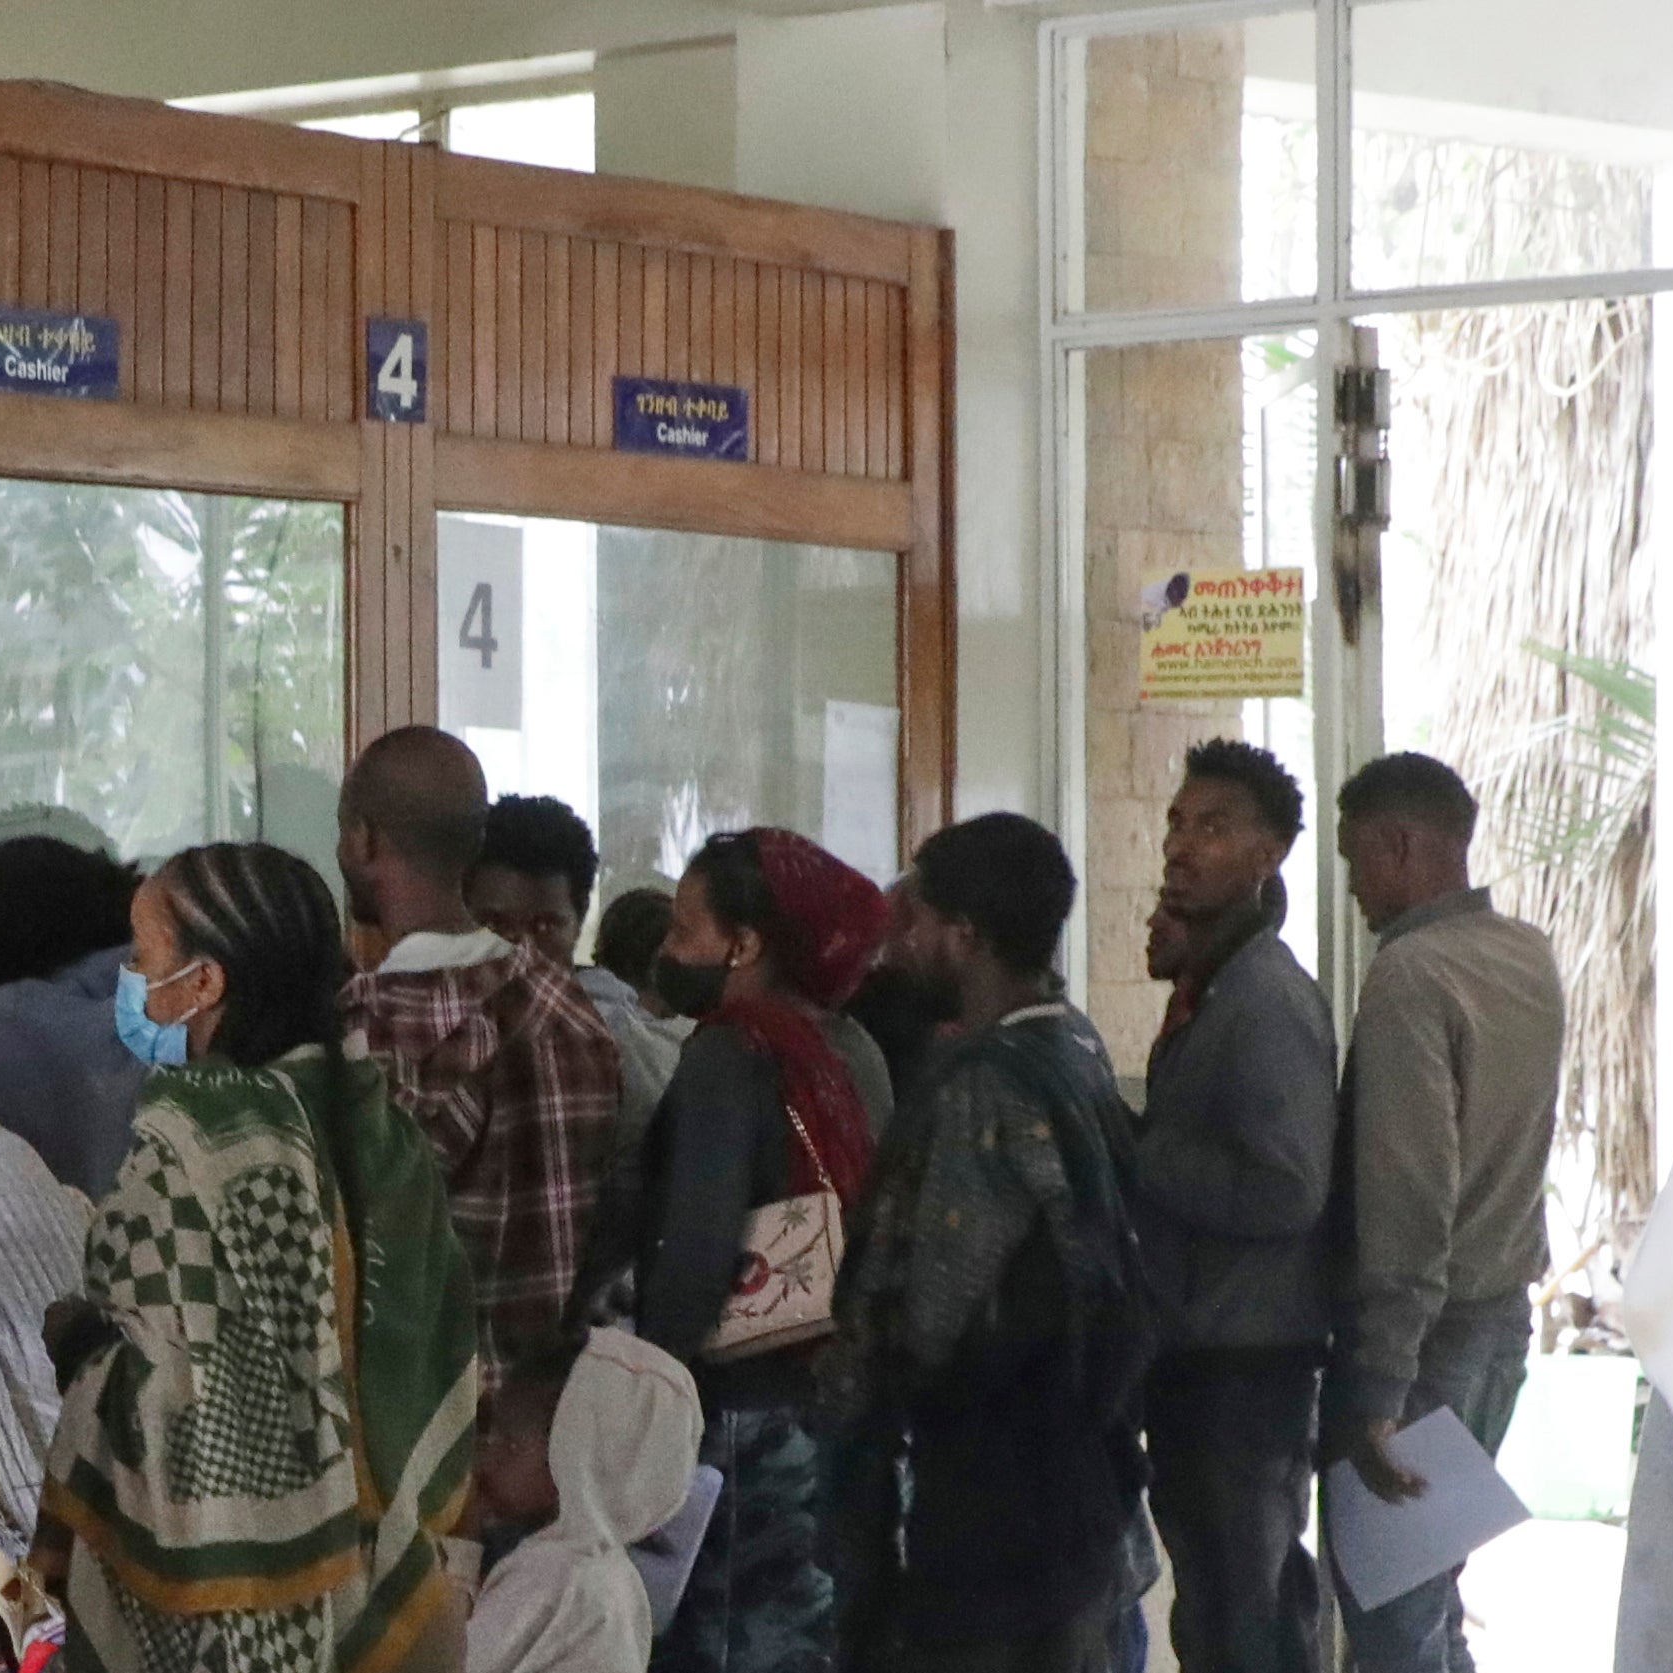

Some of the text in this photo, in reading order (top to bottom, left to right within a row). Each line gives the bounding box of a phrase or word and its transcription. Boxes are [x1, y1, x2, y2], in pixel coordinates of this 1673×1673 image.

[4, 354, 70, 384] Cashier
[377, 333, 418, 409] 4
[656, 421, 709, 448] Cashier
[459, 582, 498, 669] 4
